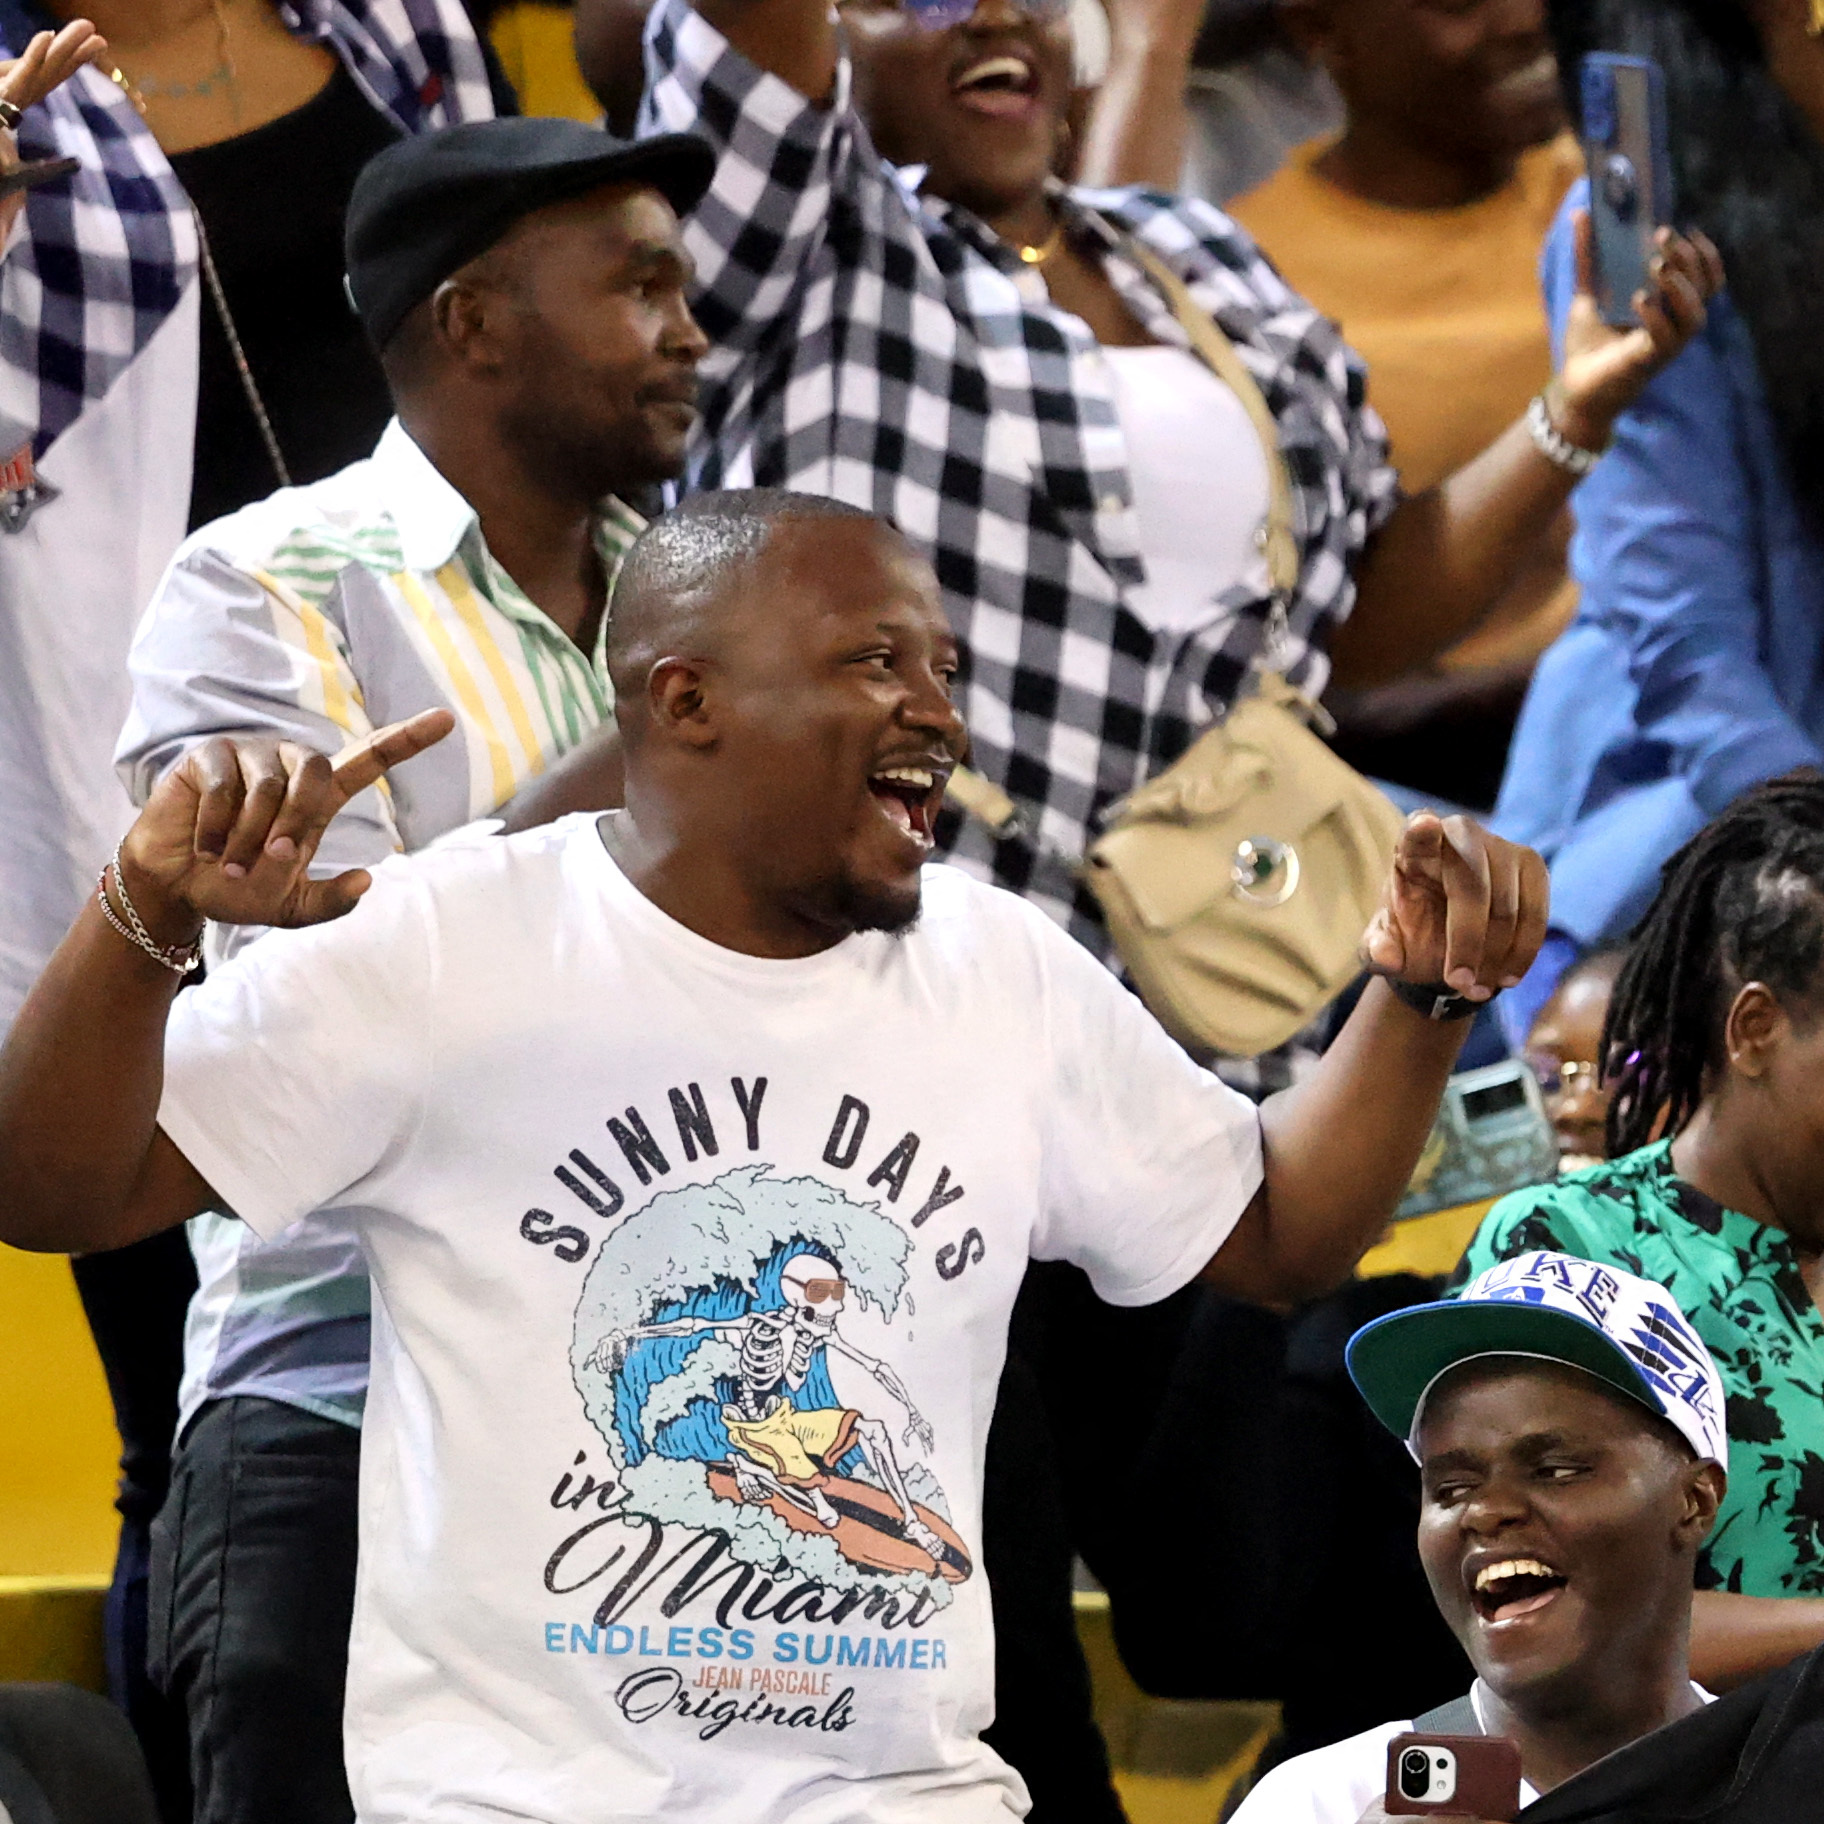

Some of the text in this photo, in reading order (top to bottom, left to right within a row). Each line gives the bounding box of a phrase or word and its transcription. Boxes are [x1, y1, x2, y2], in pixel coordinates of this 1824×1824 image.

[519, 1076, 986, 1282] SUNNY DAYS
[550, 1450, 632, 1511] in
[544, 1511, 940, 1630] Miami
[545, 1621, 947, 1670] ENDLESS SUMMER
[613, 1666, 857, 1742] Originals
[693, 1665, 833, 1697] JEAN PASCALE
